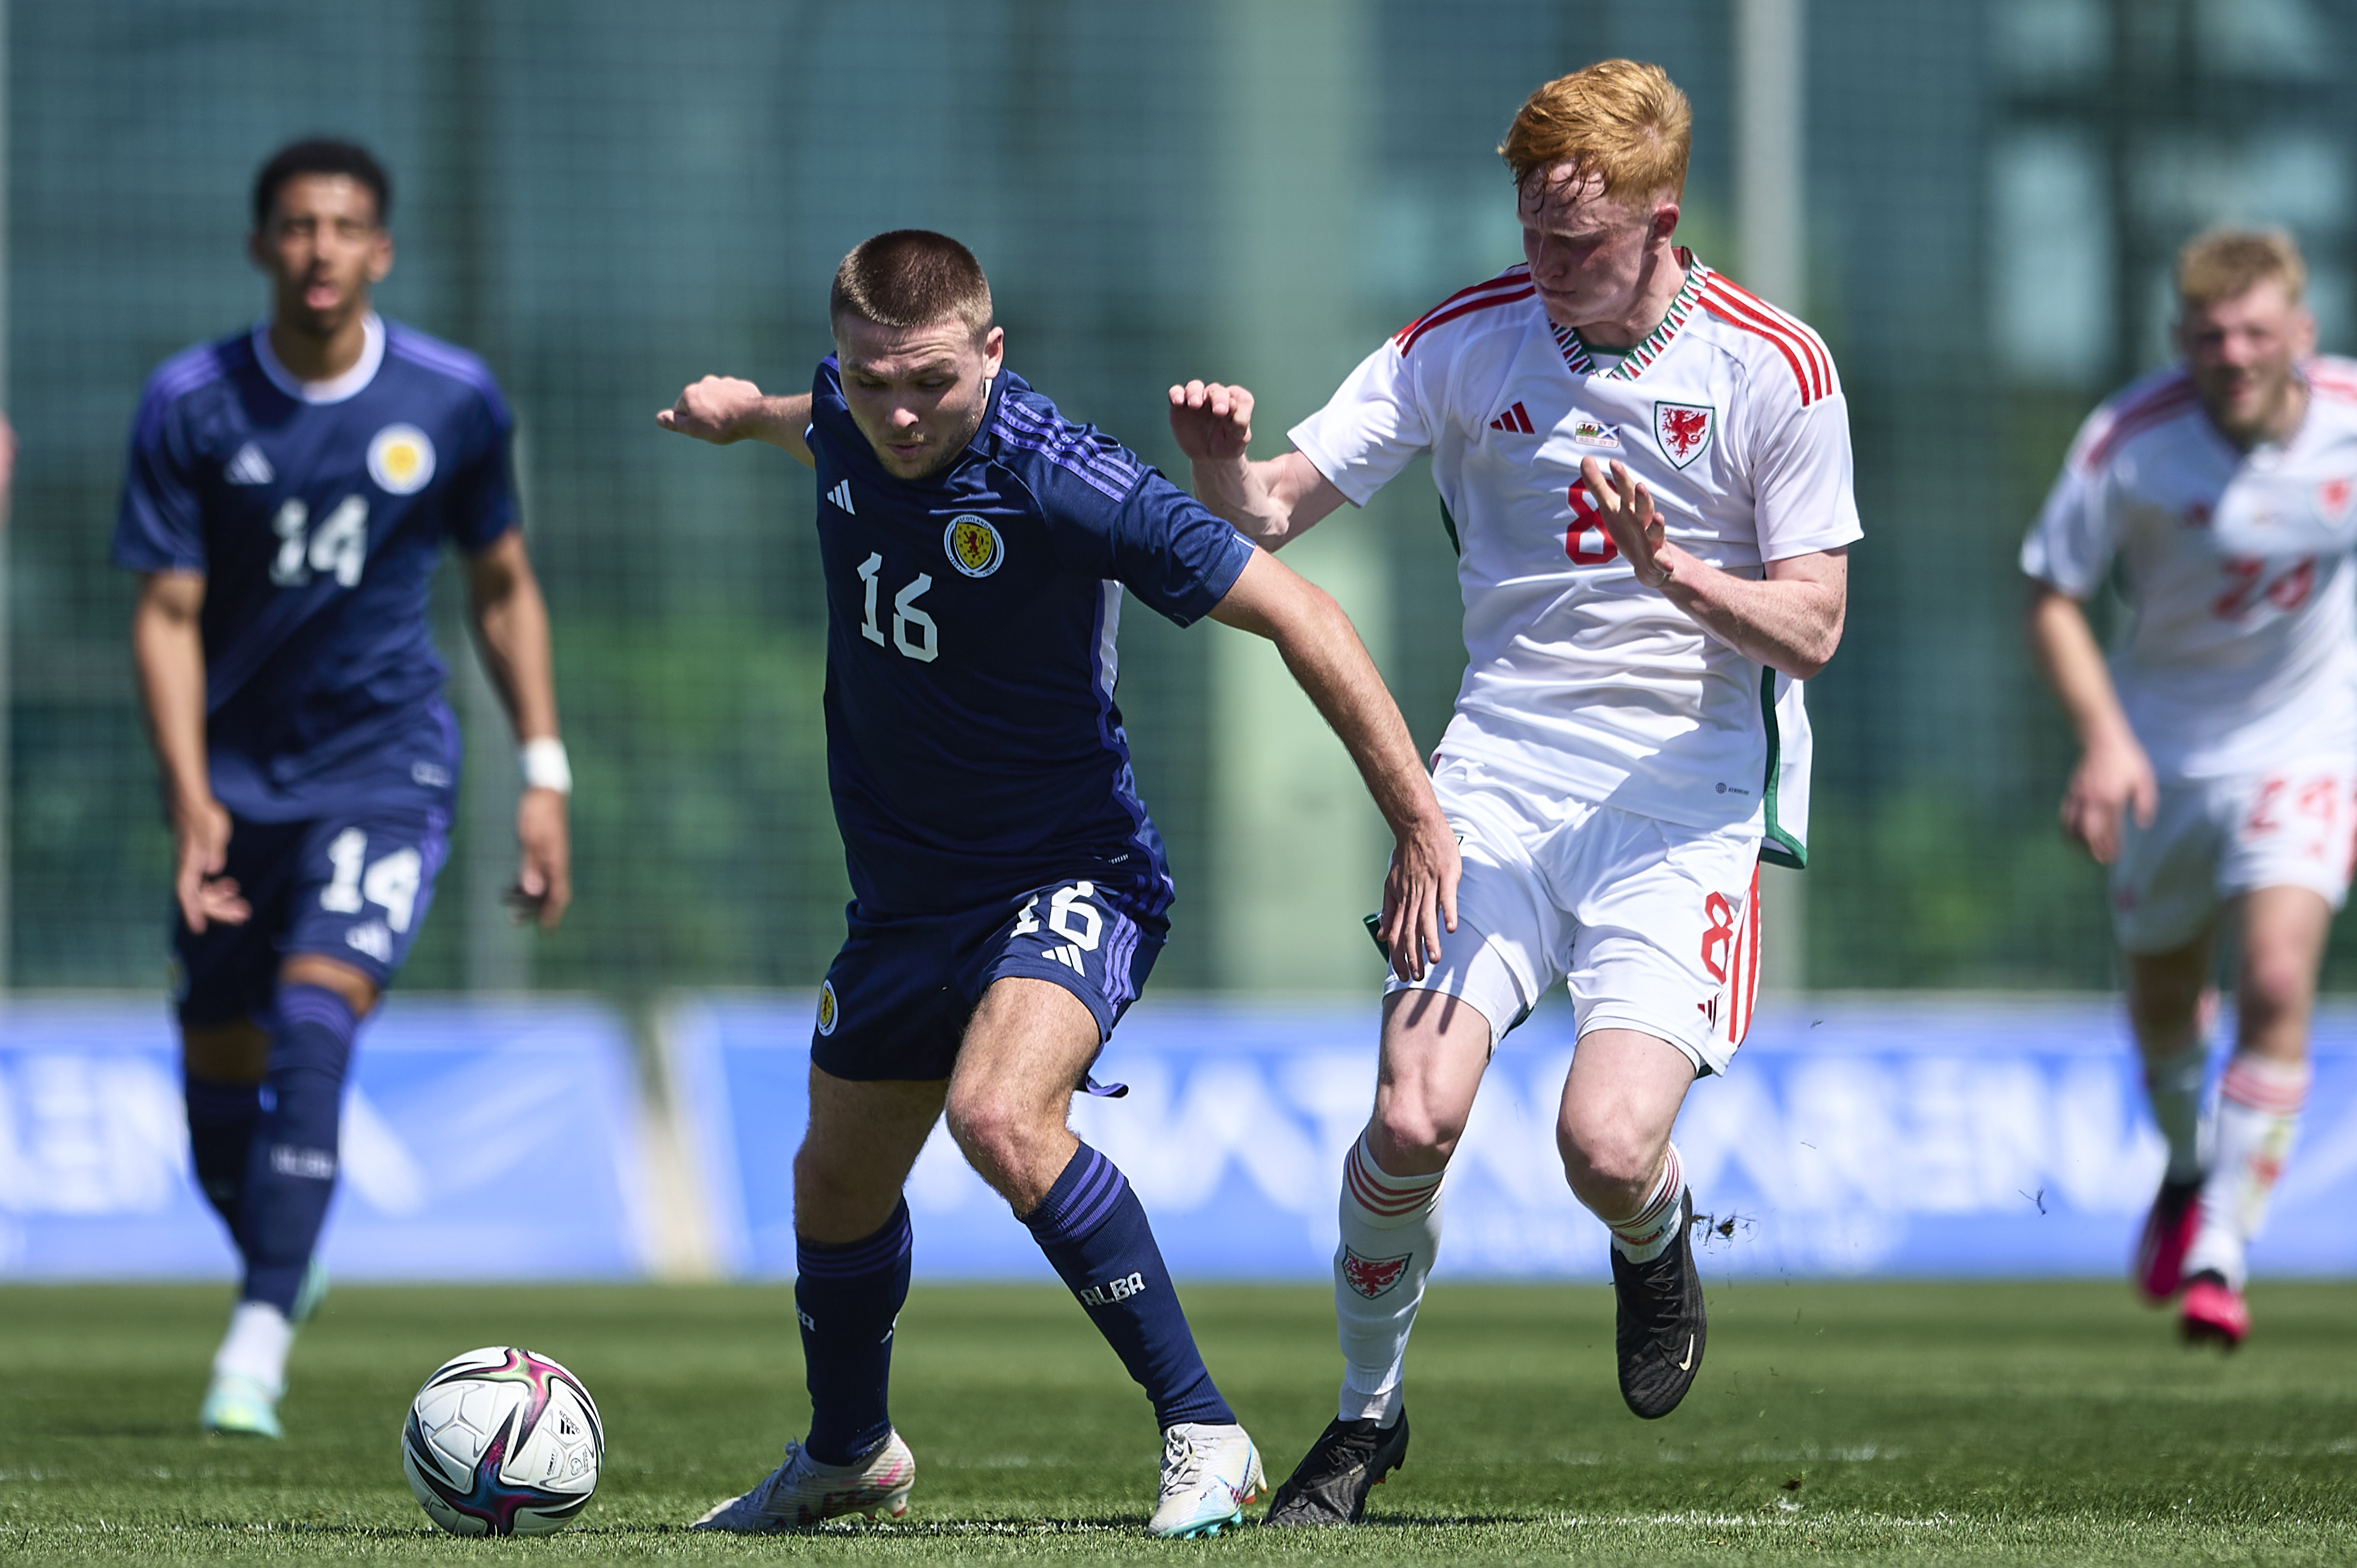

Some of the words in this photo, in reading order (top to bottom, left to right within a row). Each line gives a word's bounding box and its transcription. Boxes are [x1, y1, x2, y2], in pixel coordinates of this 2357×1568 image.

[269, 495, 369, 587] 14
[959, 517, 989, 528] SCOTLAND
[1566, 477, 1618, 566] 8
[857, 552, 939, 663] 16
[321, 827, 422, 933] 14
[1009, 881, 1103, 952] 16
[1701, 891, 1734, 985] 8
[1080, 1272, 1146, 1306] ALBA
[559, 1410, 580, 1434] adidas
